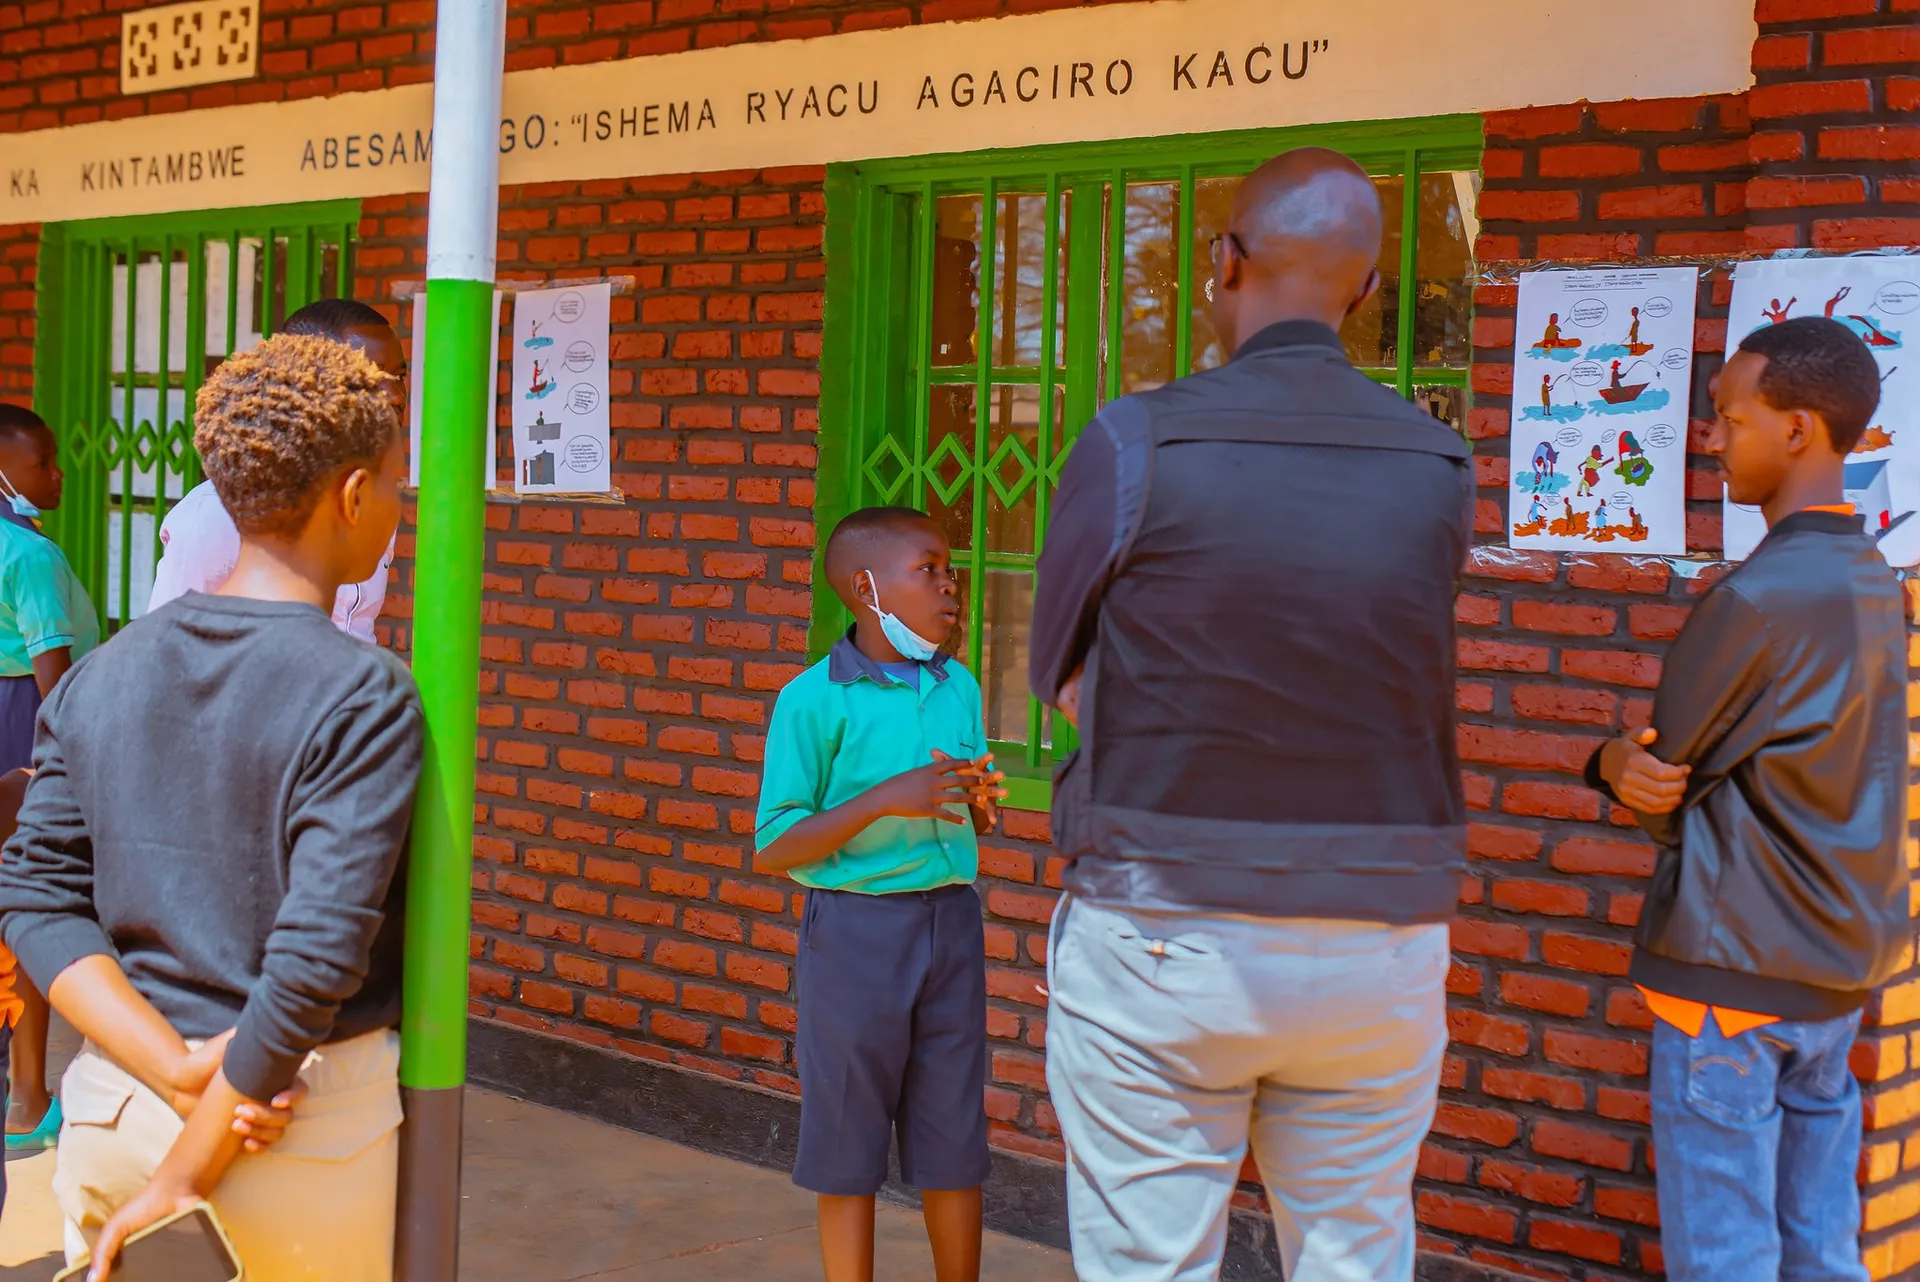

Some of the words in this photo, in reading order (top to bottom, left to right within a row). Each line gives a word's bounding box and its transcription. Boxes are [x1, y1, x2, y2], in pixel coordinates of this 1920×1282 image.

[10, 168, 40, 197] KA
[81, 145, 246, 193] KINTAMBWE
[746, 80, 879, 125] RYACU
[915, 58, 1132, 110] AGACIRO
[1173, 39, 1329, 91] KACU”
